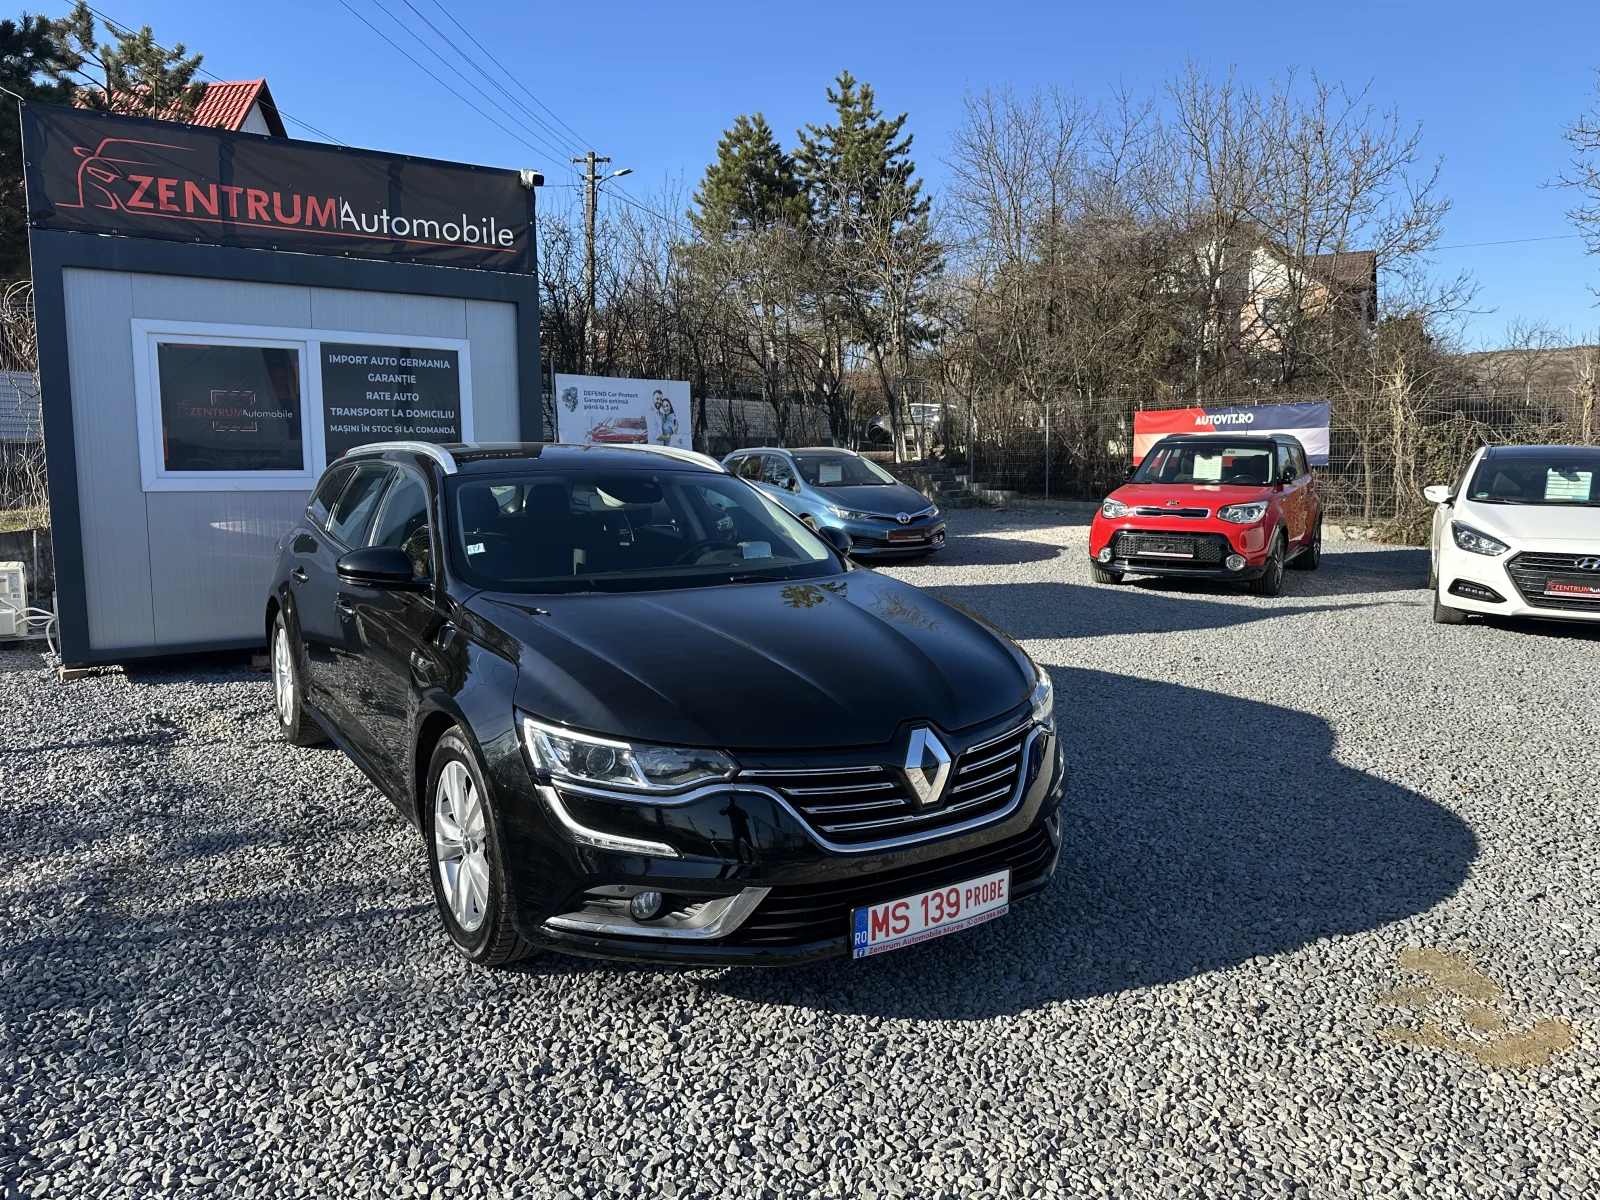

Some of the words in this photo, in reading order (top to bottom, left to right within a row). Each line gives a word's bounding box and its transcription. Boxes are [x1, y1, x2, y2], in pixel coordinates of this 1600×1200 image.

[126, 174, 337, 228] ZENTRUM
[340, 199, 514, 247] Automobile
[329, 354, 368, 365] IMPORT
[370, 356, 398, 366] AUTO
[400, 357, 451, 369] GERMANIA
[367, 373, 417, 385] GARANȚIE
[366, 391, 391, 401] RATE
[393, 392, 419, 402] AUTO
[189, 407, 242, 418] ZENTRUM
[242, 408, 293, 419] Automobile
[330, 407, 389, 417] TRANSPORT
[391, 408, 404, 417] LA
[406, 409, 455, 419] DOMICILIU
[1194, 412, 1254, 426] AUTOVIT.RO
[330, 424, 359, 434] MAȘINI
[361, 423, 370, 433] ÎN
[372, 425, 393, 433] STOC
[394, 425, 402, 435] ȘI
[403, 426, 414, 434] LA
[415, 425, 456, 435] COMANDĂ
[1554, 584, 1590, 592] ZENTRUM
[871, 901, 910, 942] MS
[920, 887, 961, 927] 139
[965, 878, 1005, 909] PROBE
[854, 930, 867, 945] RO
[868, 941, 901, 955] Zentrum
[902, 929, 942, 946] Automobile
